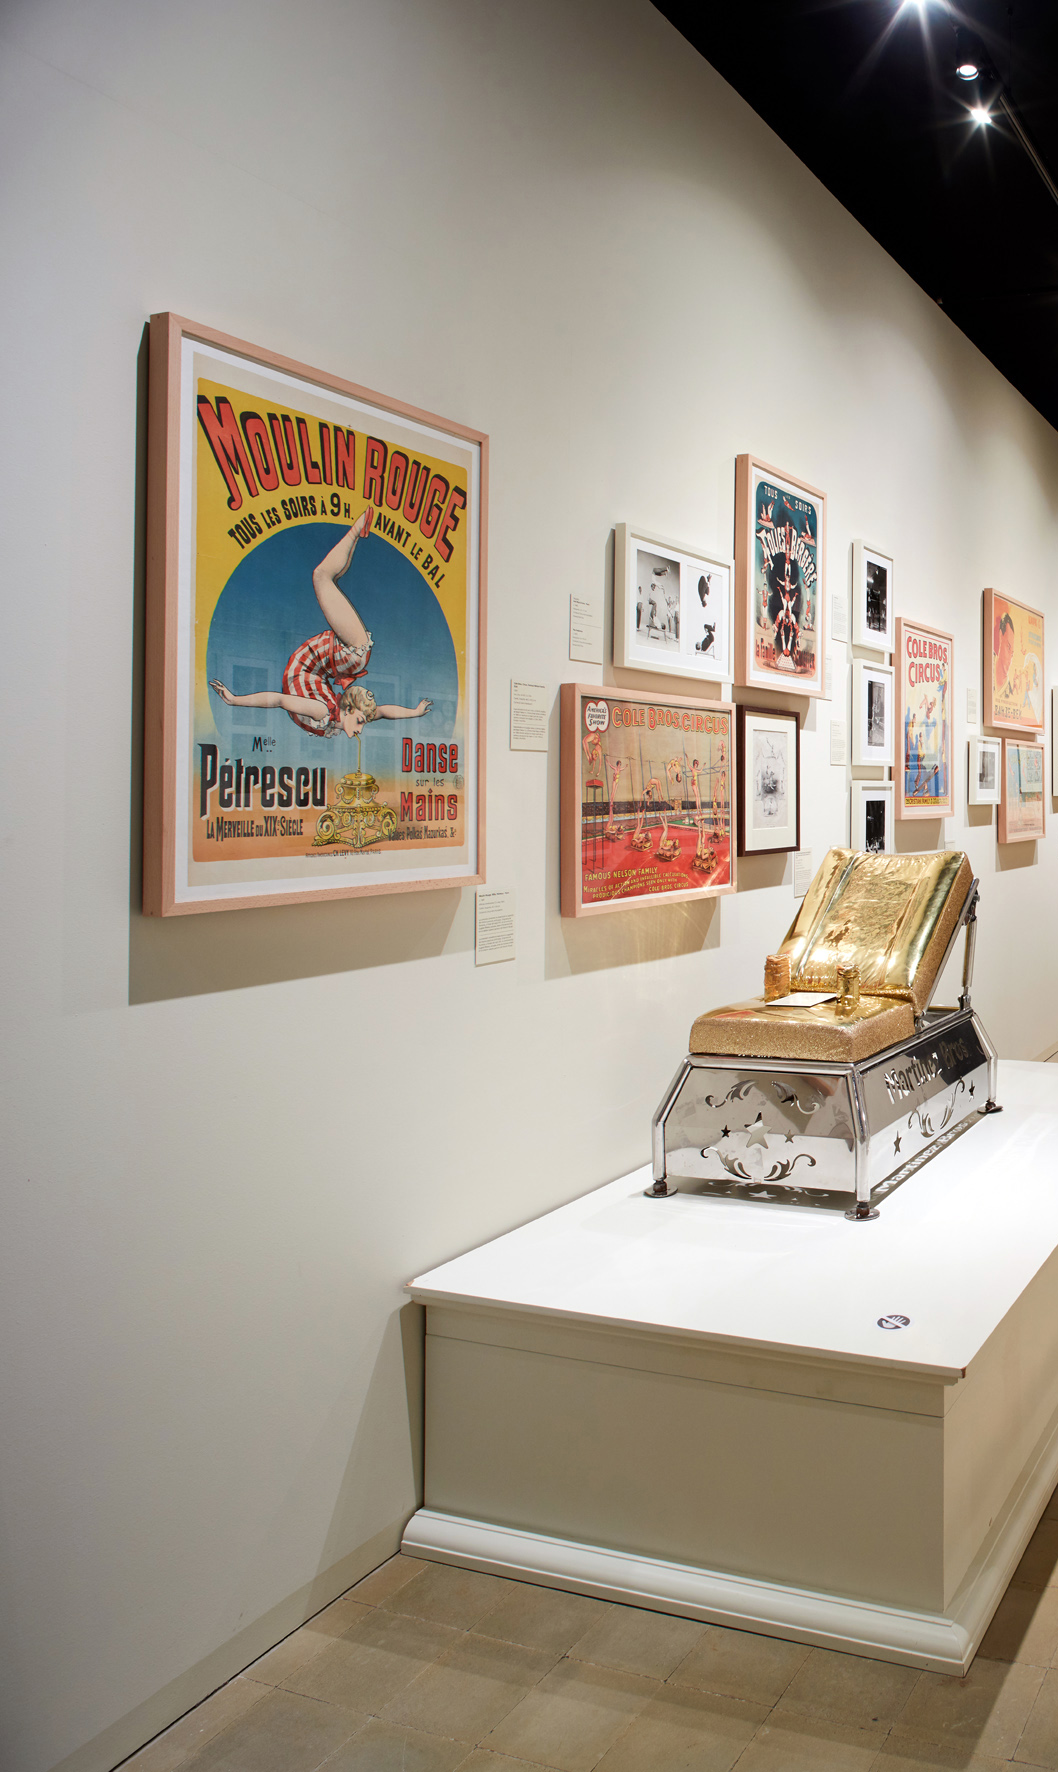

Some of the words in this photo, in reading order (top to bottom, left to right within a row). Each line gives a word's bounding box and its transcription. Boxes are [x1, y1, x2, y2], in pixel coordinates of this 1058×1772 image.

[197, 395, 355, 511] MOULIN
[362, 436, 468, 563] ROUGE
[764, 485, 777, 499] TOUS
[795, 500, 812, 515] SOIRS
[227, 512, 263, 549] TOUS
[261, 506, 281, 530] LES
[281, 495, 317, 521] SOIRS
[330, 493, 341, 517] 9
[374, 512, 411, 548] AVANT
[410, 542, 424, 561] LE
[421, 557, 446, 589] BAL
[907, 636, 927, 659] COLE
[928, 641, 949, 666] BROS.
[908, 661, 941, 688] CIRCUS
[612, 706, 645, 728] COLE
[681, 712, 728, 735] CIRCUS
[401, 737, 459, 773] Danse
[197, 743, 328, 820] Pétrescu
[415, 778, 430, 788] sur
[433, 777, 445, 787] les
[400, 788, 458, 823] Mains
[216, 816, 254, 842] MERVEILLE
[255, 824, 264, 837] DU
[583, 884, 607, 893] MIRACLES
[584, 871, 611, 882] FAMOUS
[613, 868, 637, 879] NELSON
[638, 866, 658, 875] FAMILY
[621, 882, 646, 894] CHAMPIONS
[673, 881, 689, 889] CIRCUS
